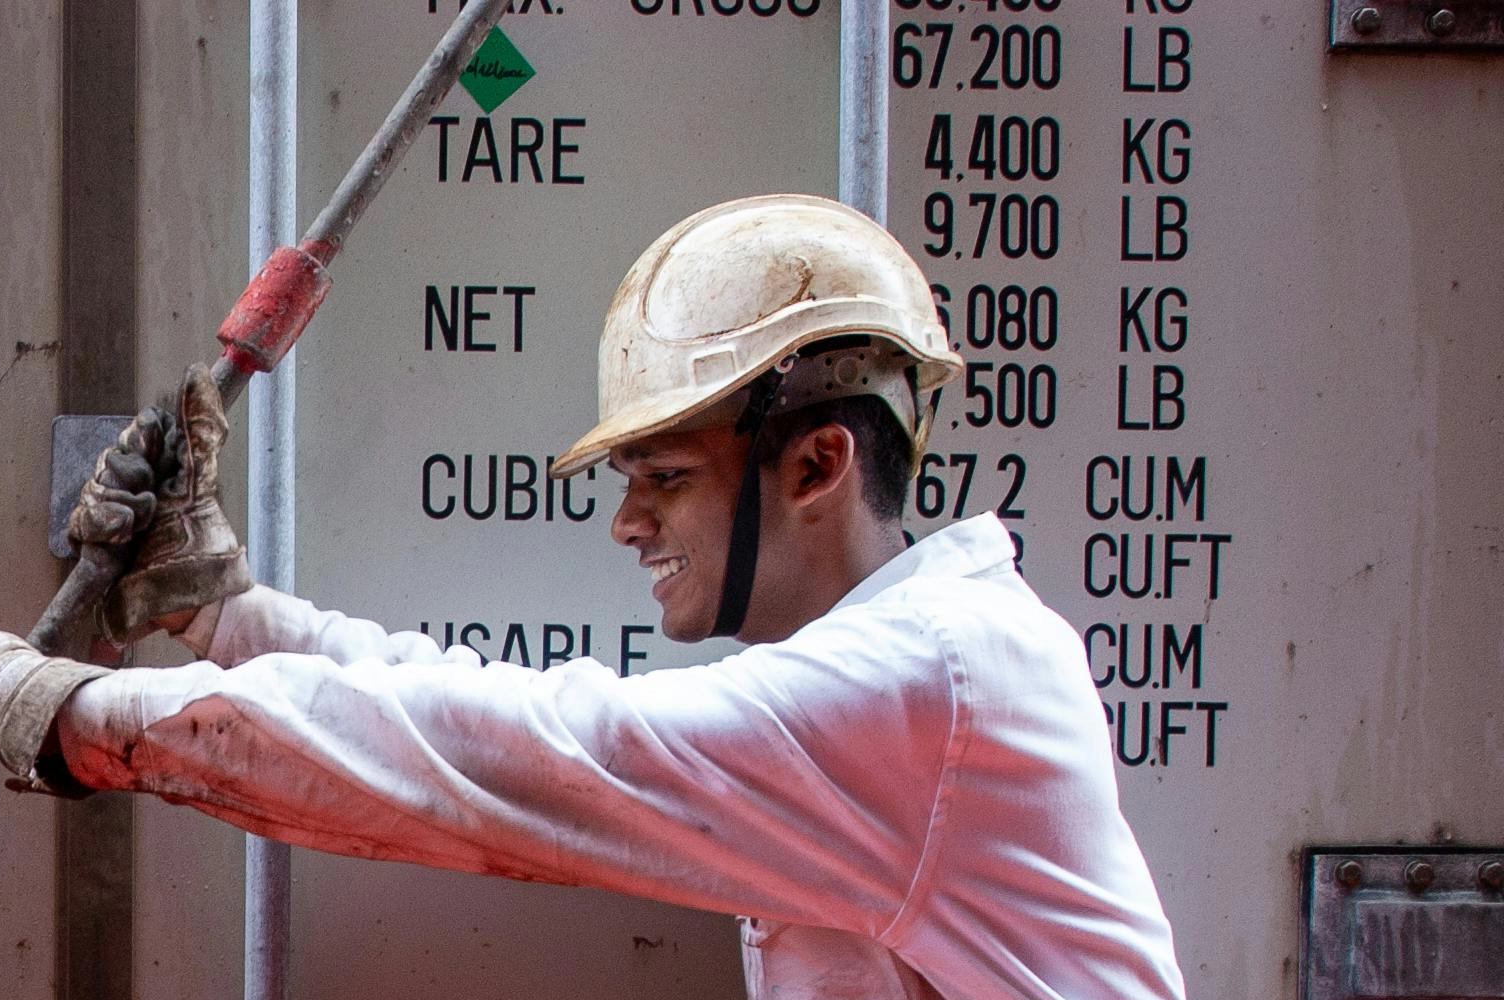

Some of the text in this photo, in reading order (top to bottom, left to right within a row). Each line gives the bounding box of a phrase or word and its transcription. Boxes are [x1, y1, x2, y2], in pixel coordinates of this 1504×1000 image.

[893, 22, 1192, 93] 67,200 LB
[428, 114, 1192, 185] TARE 4,400 KG
[923, 192, 1189, 262] 9,700 LB
[424, 285, 537, 353] NET
[1119, 286, 1189, 352] KG
[930, 362, 1187, 431] ,500 LB
[422, 453, 596, 522] CUBIC
[1085, 455, 1207, 521] CU.M
[1084, 533, 1233, 600] CU.FT
[420, 622, 1202, 690] SABE CU.M
[1102, 702, 1228, 768] U.FT
